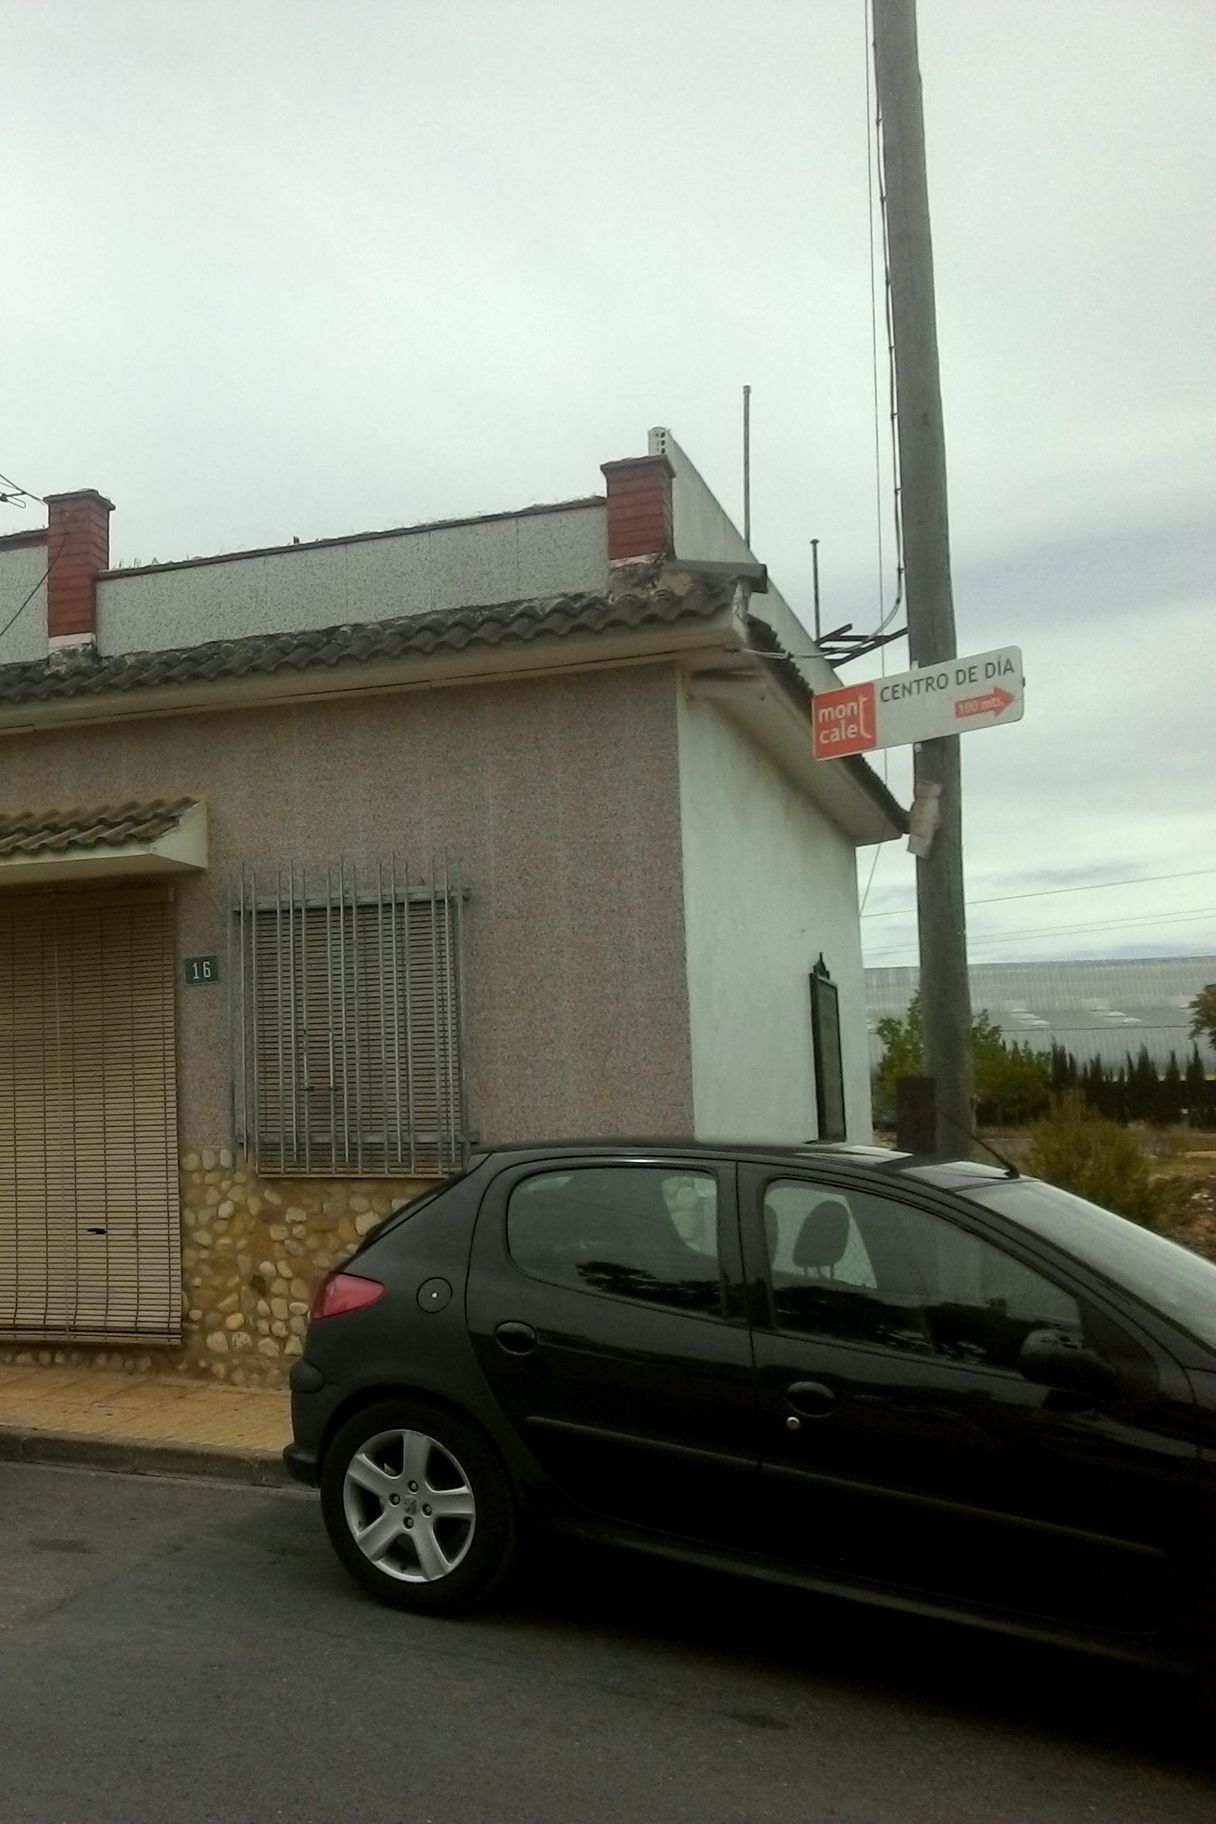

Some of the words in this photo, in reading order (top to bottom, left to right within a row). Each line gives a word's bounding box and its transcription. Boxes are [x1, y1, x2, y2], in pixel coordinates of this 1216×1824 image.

[880, 673, 949, 702] CENTRO
[956, 665, 978, 686] DE
[985, 655, 1015, 680] DÍA
[192, 960, 212, 980] 16
